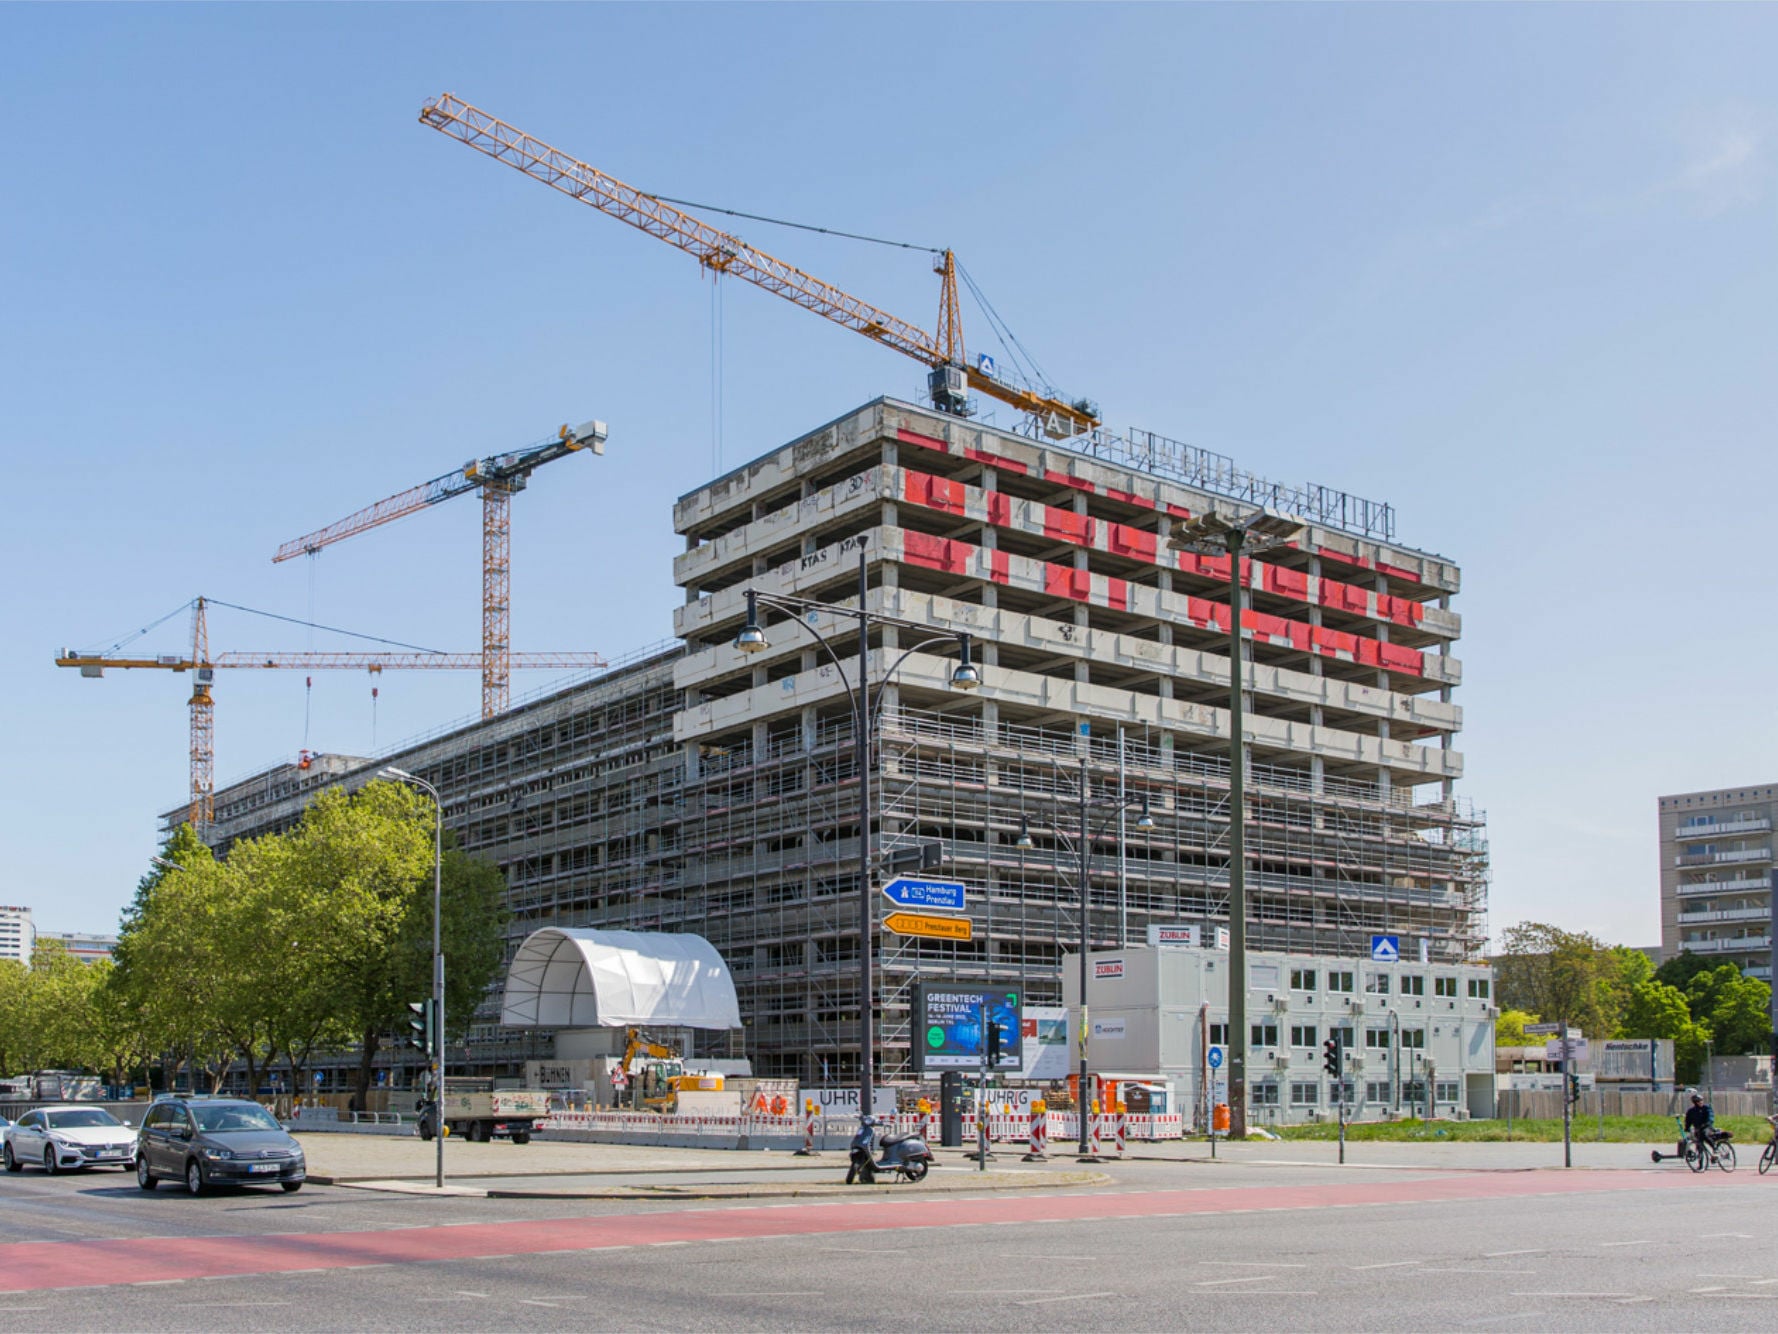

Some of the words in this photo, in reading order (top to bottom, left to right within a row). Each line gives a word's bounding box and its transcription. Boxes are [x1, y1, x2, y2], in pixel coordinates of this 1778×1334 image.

[925, 885, 957, 897] Hamburg
[927, 993, 984, 1004] GREENTECH
[927, 1003, 972, 1013] FESTIVAL
[987, 1090, 1028, 1105] UHRIG
